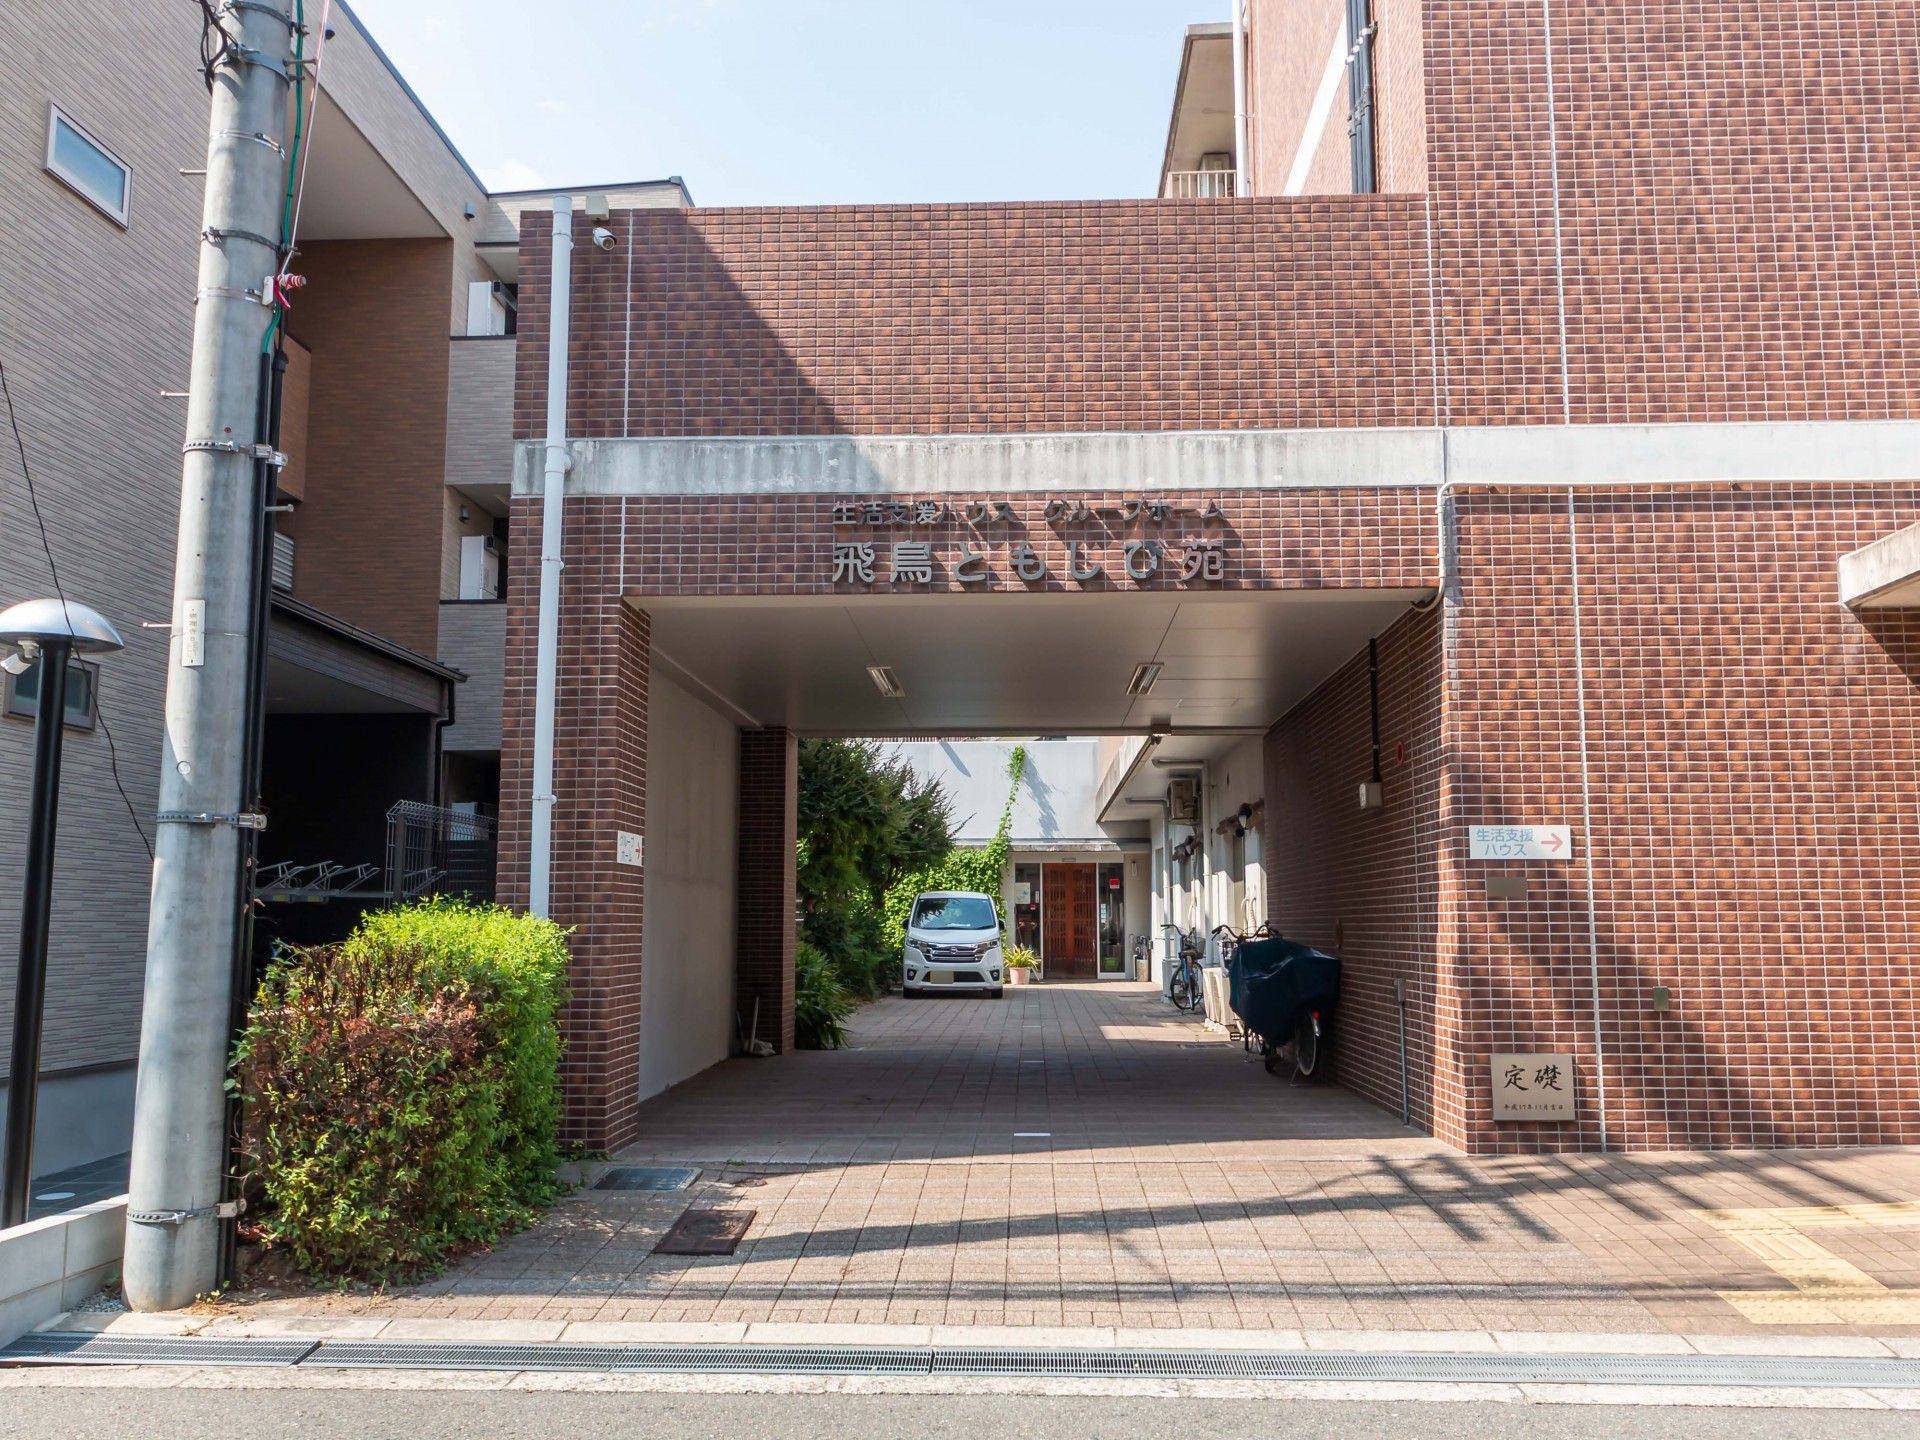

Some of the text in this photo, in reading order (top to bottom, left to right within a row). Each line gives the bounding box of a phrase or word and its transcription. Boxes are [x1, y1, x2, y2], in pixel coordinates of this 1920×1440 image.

[832, 498, 1224, 525] 生活支援ハウス グループホーム
[832, 537, 1224, 584] 飛鳥ともしび苑
[1476, 828, 1534, 843] 生活支援
[1484, 843, 1527, 857] ハウス
[1503, 1064, 1563, 1091] 定礎
